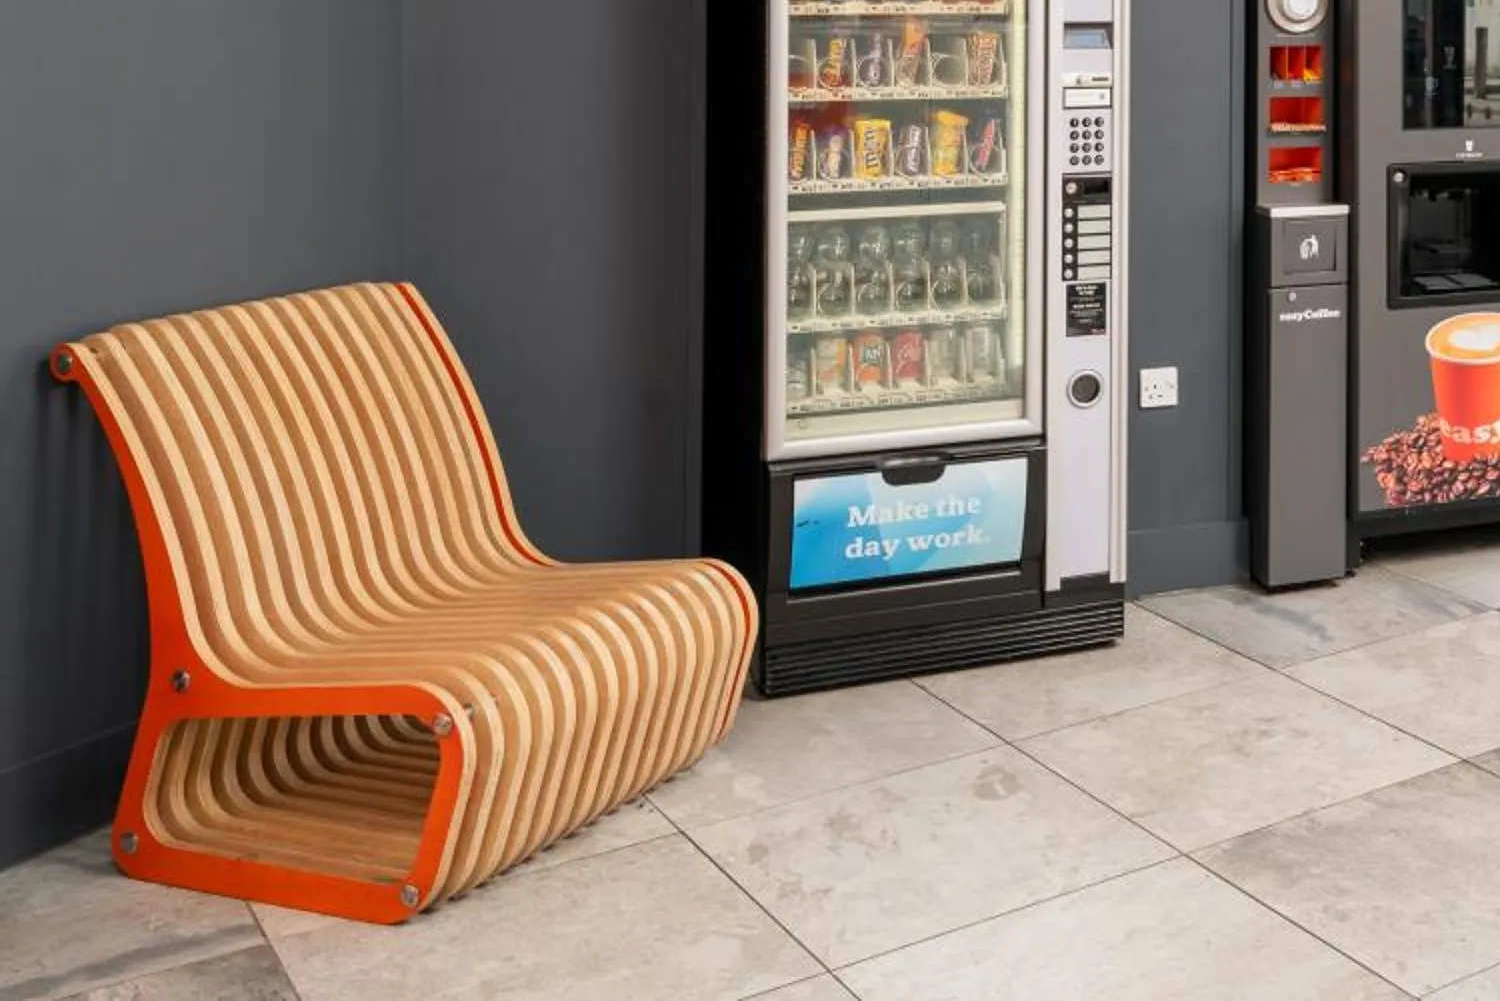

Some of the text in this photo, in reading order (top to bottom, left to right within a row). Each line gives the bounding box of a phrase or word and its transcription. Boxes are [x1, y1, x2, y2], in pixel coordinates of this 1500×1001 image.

[1279, 307, 1342, 323] easyCoffee
[847, 493, 982, 528] Make the
[844, 524, 991, 562] day work.
